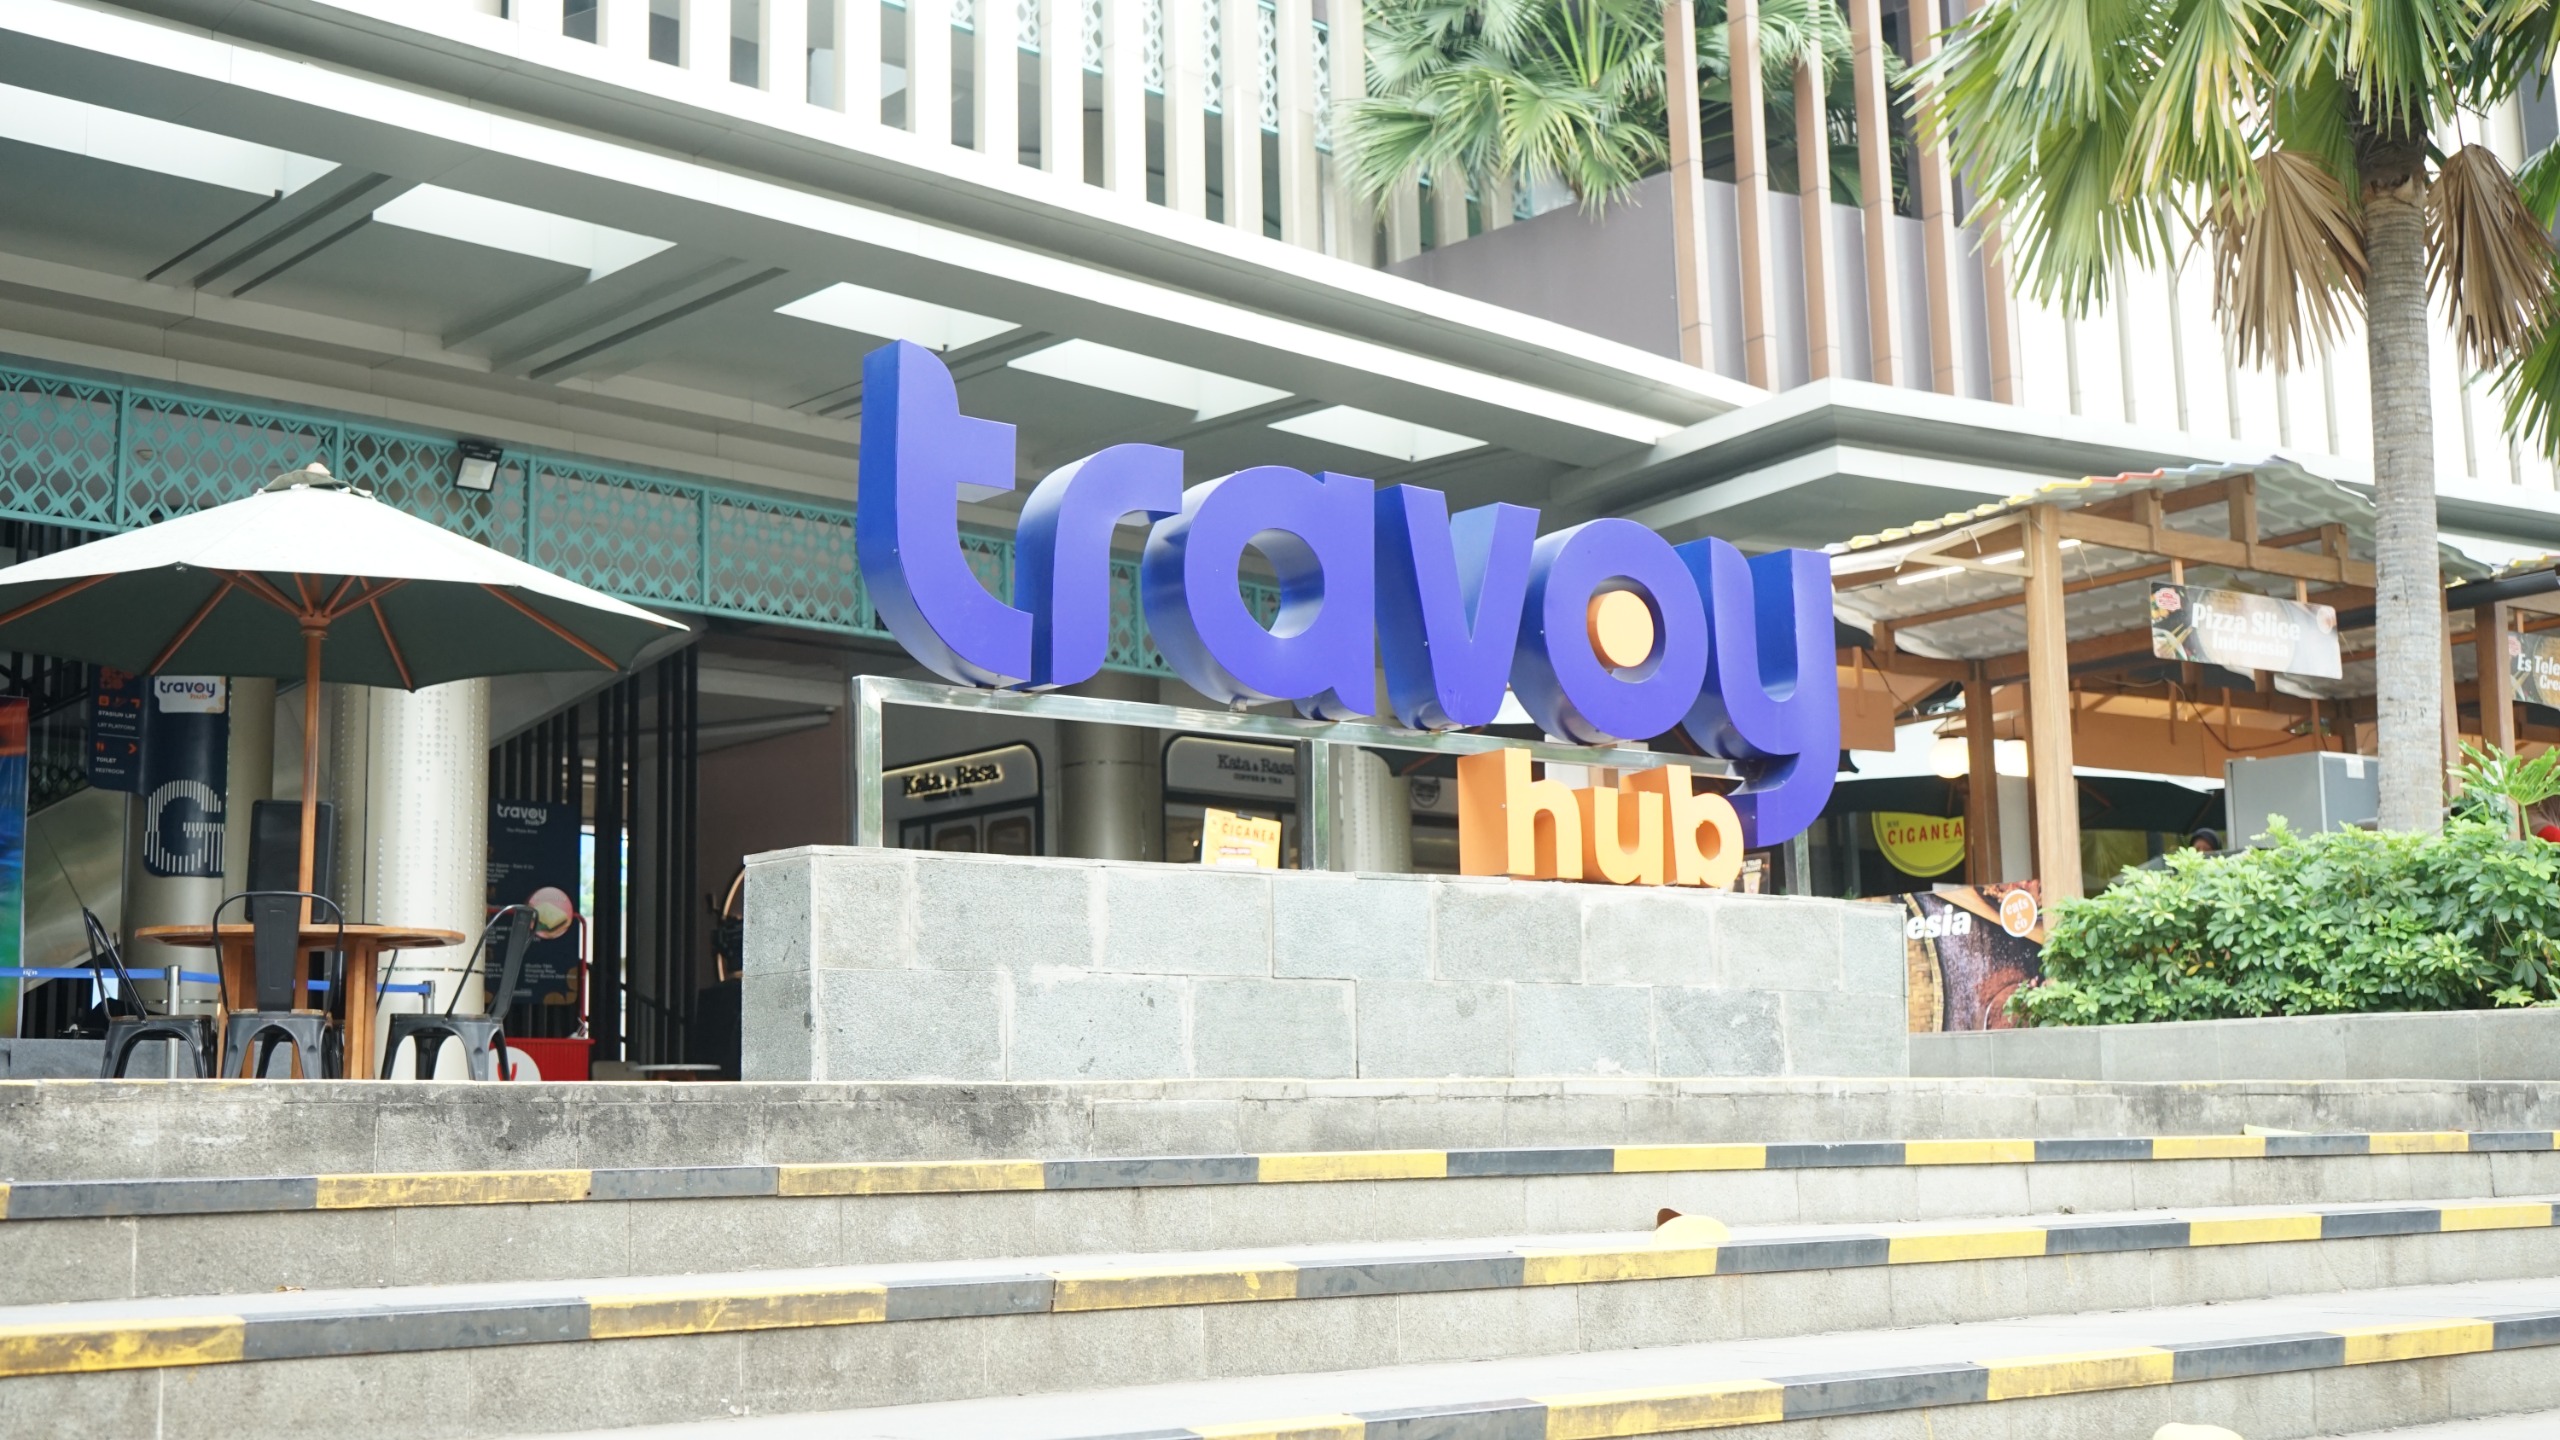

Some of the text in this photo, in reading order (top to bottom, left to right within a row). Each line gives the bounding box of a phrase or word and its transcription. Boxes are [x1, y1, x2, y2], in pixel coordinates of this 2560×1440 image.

[858, 340, 1840, 847] travoy
[2191, 602, 2301, 642] Pizza Slice
[2211, 629, 2289, 658] Indonesia
[2517, 653, 2532, 673] Es
[160, 681, 215, 698] travoy
[1216, 753, 1250, 773] Kata
[1260, 757, 1296, 776] Rasa
[902, 773, 943, 796] Kata
[955, 764, 1000, 786] Rasa
[497, 804, 547, 825] travoy
[1457, 748, 1744, 889] hub
[1887, 821, 1964, 847] CIGANEA
[2005, 897, 2029, 916] eats
